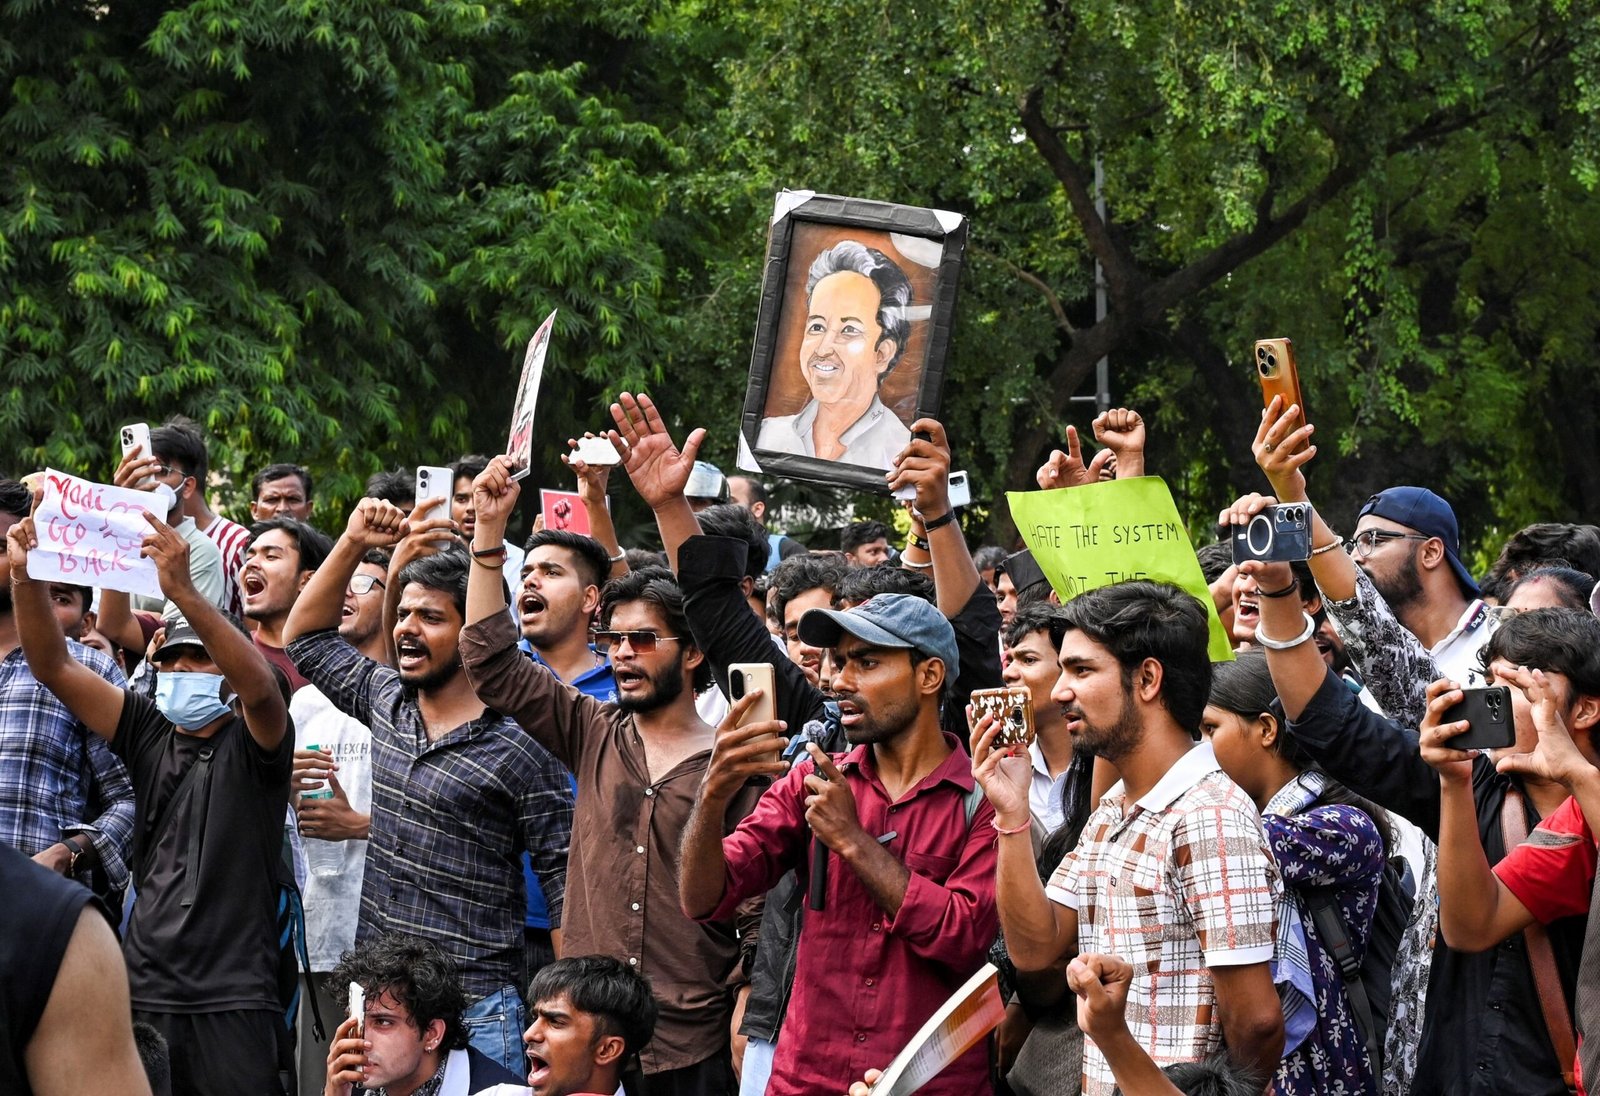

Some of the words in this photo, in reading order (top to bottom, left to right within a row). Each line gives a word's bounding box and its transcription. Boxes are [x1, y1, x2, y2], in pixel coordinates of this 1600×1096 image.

[1028, 524, 1061, 549] HATE
[1070, 525, 1099, 549] THE
[1113, 523, 1180, 545] SYSTEM
[344, 742, 371, 755] EXCH
